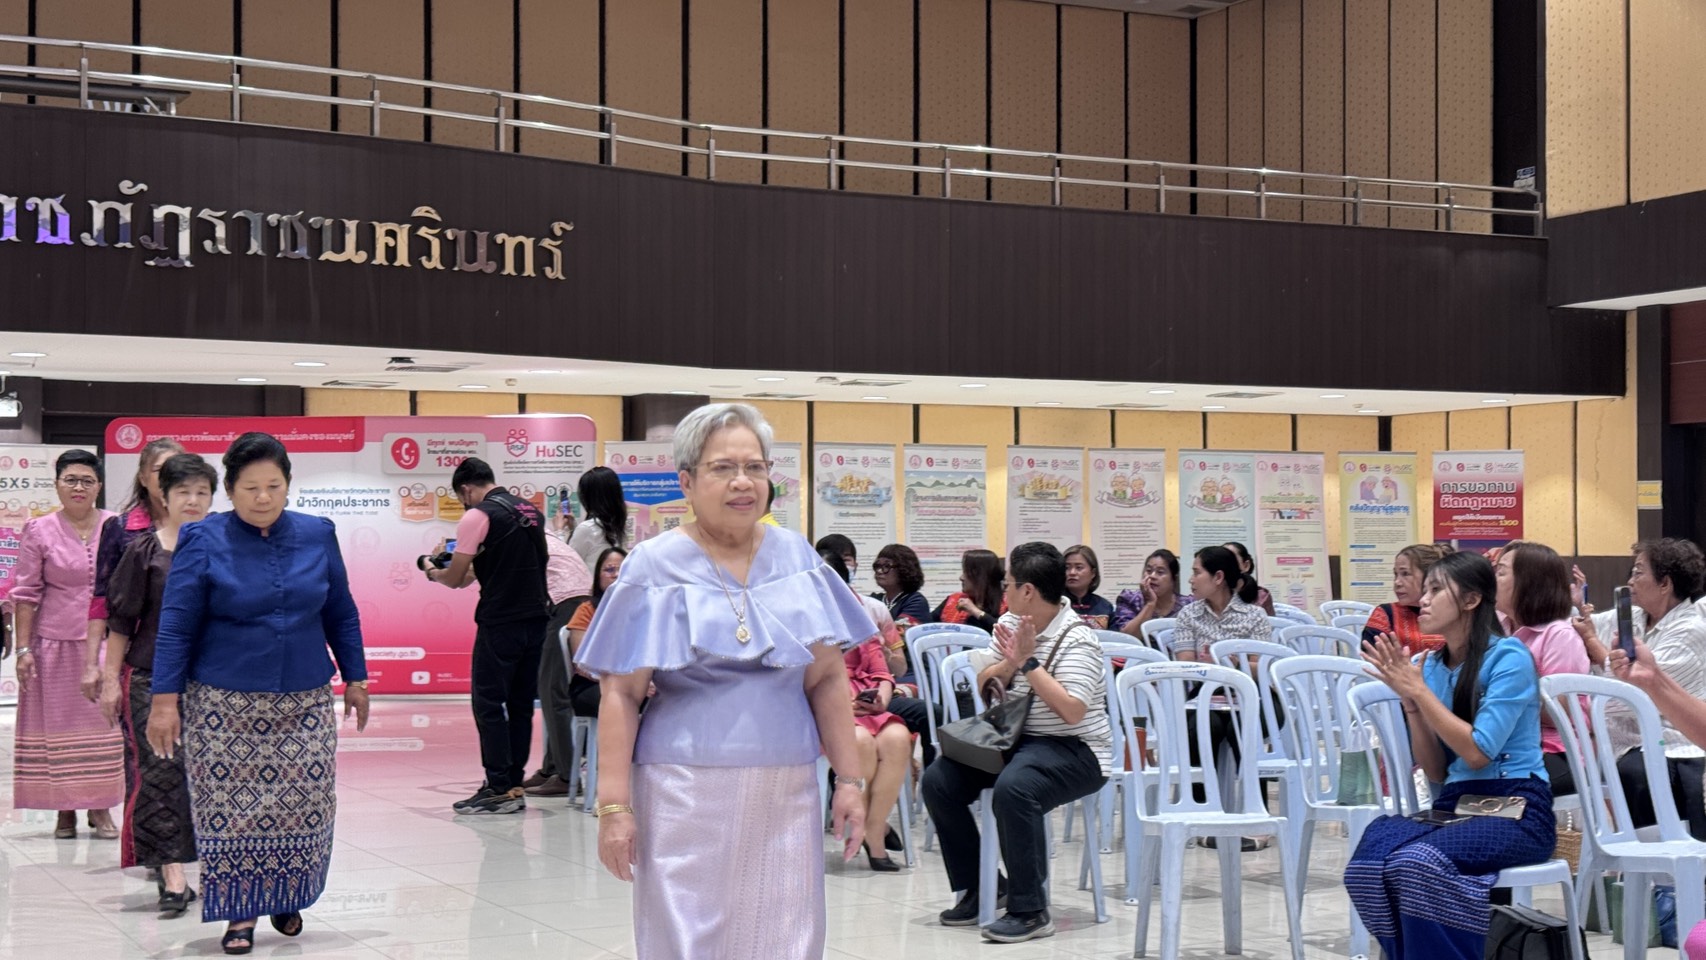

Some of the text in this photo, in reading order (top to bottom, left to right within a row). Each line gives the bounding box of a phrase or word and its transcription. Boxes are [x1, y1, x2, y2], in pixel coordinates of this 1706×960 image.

[535, 445, 583, 458] HuSEC
[1440, 481, 1518, 494] การขอทาน
[296, 496, 391, 510] ฝ่าวิกฤตประชากร
[1440, 495, 1518, 511] ผิดกฎหมาย
